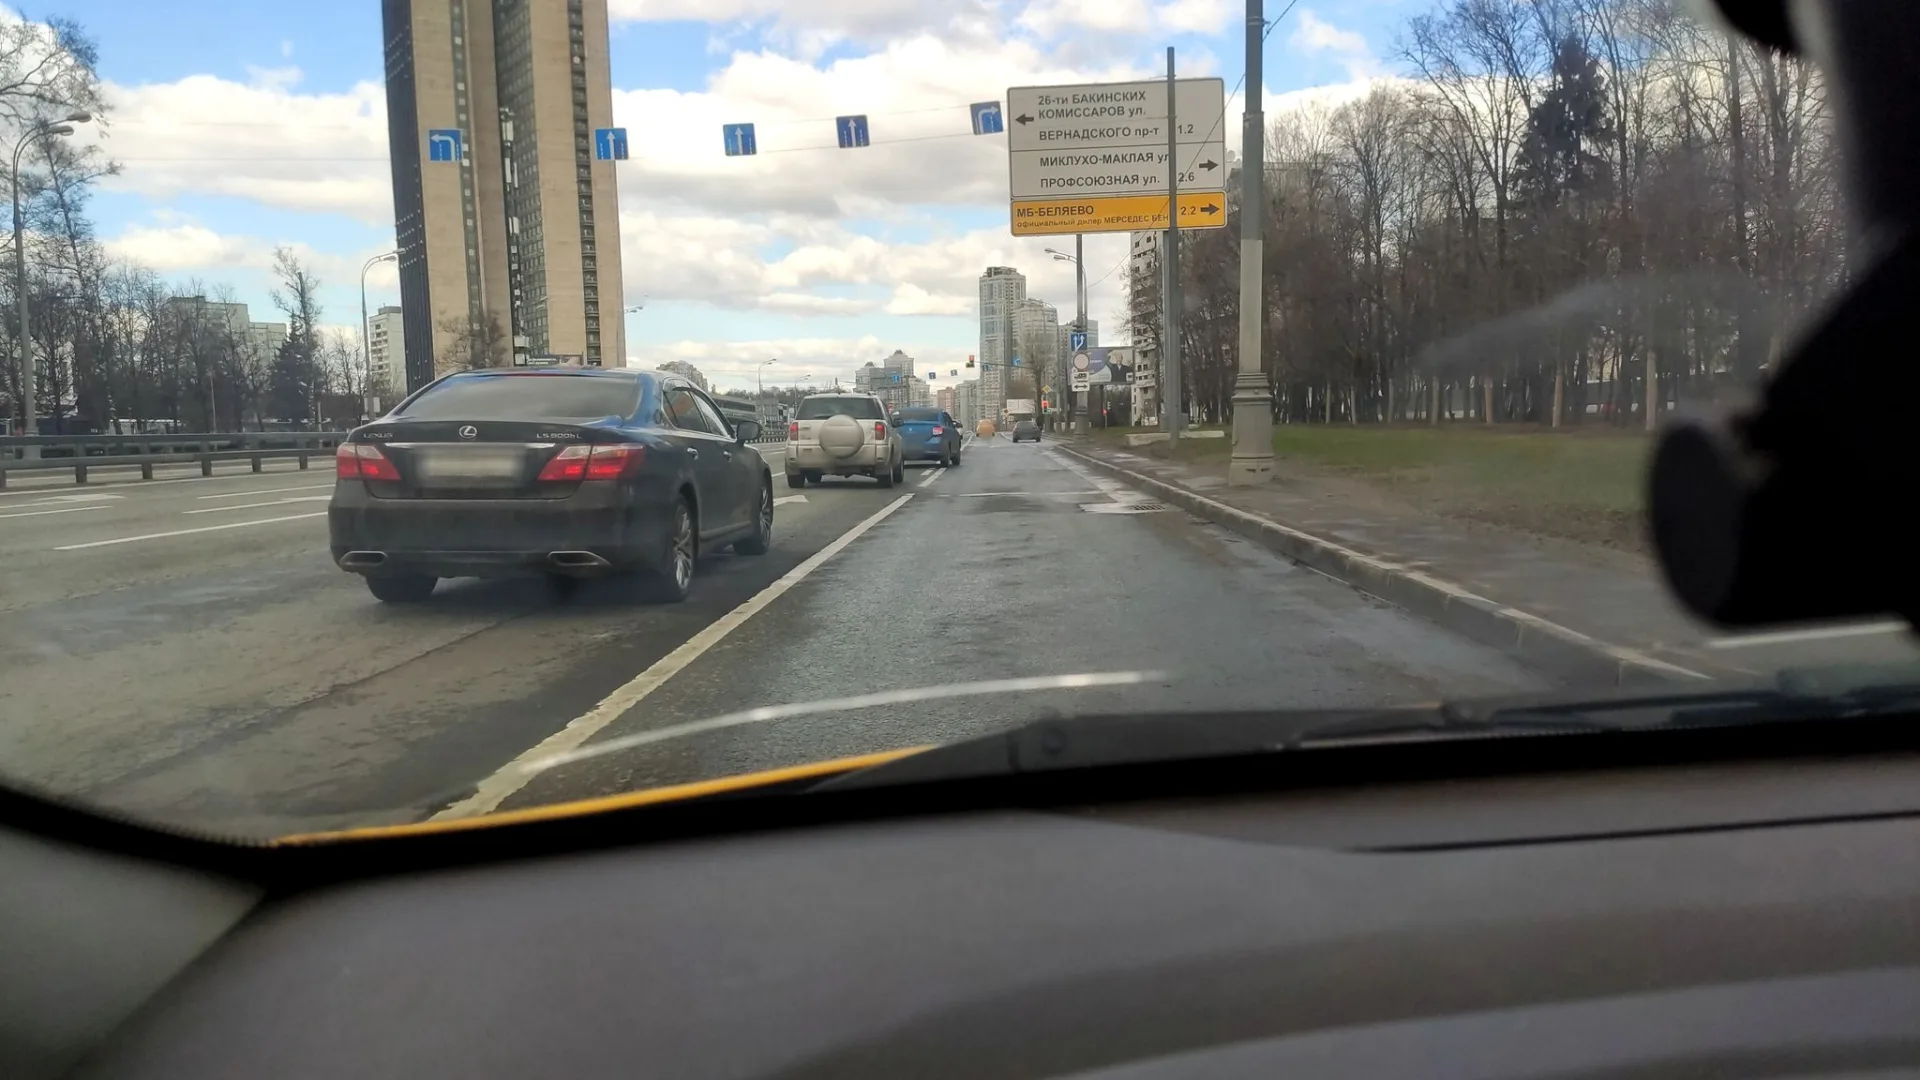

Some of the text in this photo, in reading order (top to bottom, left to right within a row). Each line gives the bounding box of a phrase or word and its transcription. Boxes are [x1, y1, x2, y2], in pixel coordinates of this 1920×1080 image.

[1038, 91, 1146, 106] 26-ти БАКИНСКИХ
[1038, 106, 1146, 119] КОМИССАРОВ ул.
[1039, 124, 1194, 141] ВЕРНАДСКОГО пр-т 1.2
[1040, 152, 1169, 167] МИКЛУХО-МАКЛАЯ ул
[1040, 172, 1195, 188] ПРОФСОЮЗНАЯ ул. 2.6
[1016, 205, 1197, 217] МБ-БЕЛЯЕВО 2.2
[1016, 220, 1075, 228] официальный
[1104, 215, 1149, 224] МЕРСЕДЕС
[1151, 214, 1169, 222] БЕН
